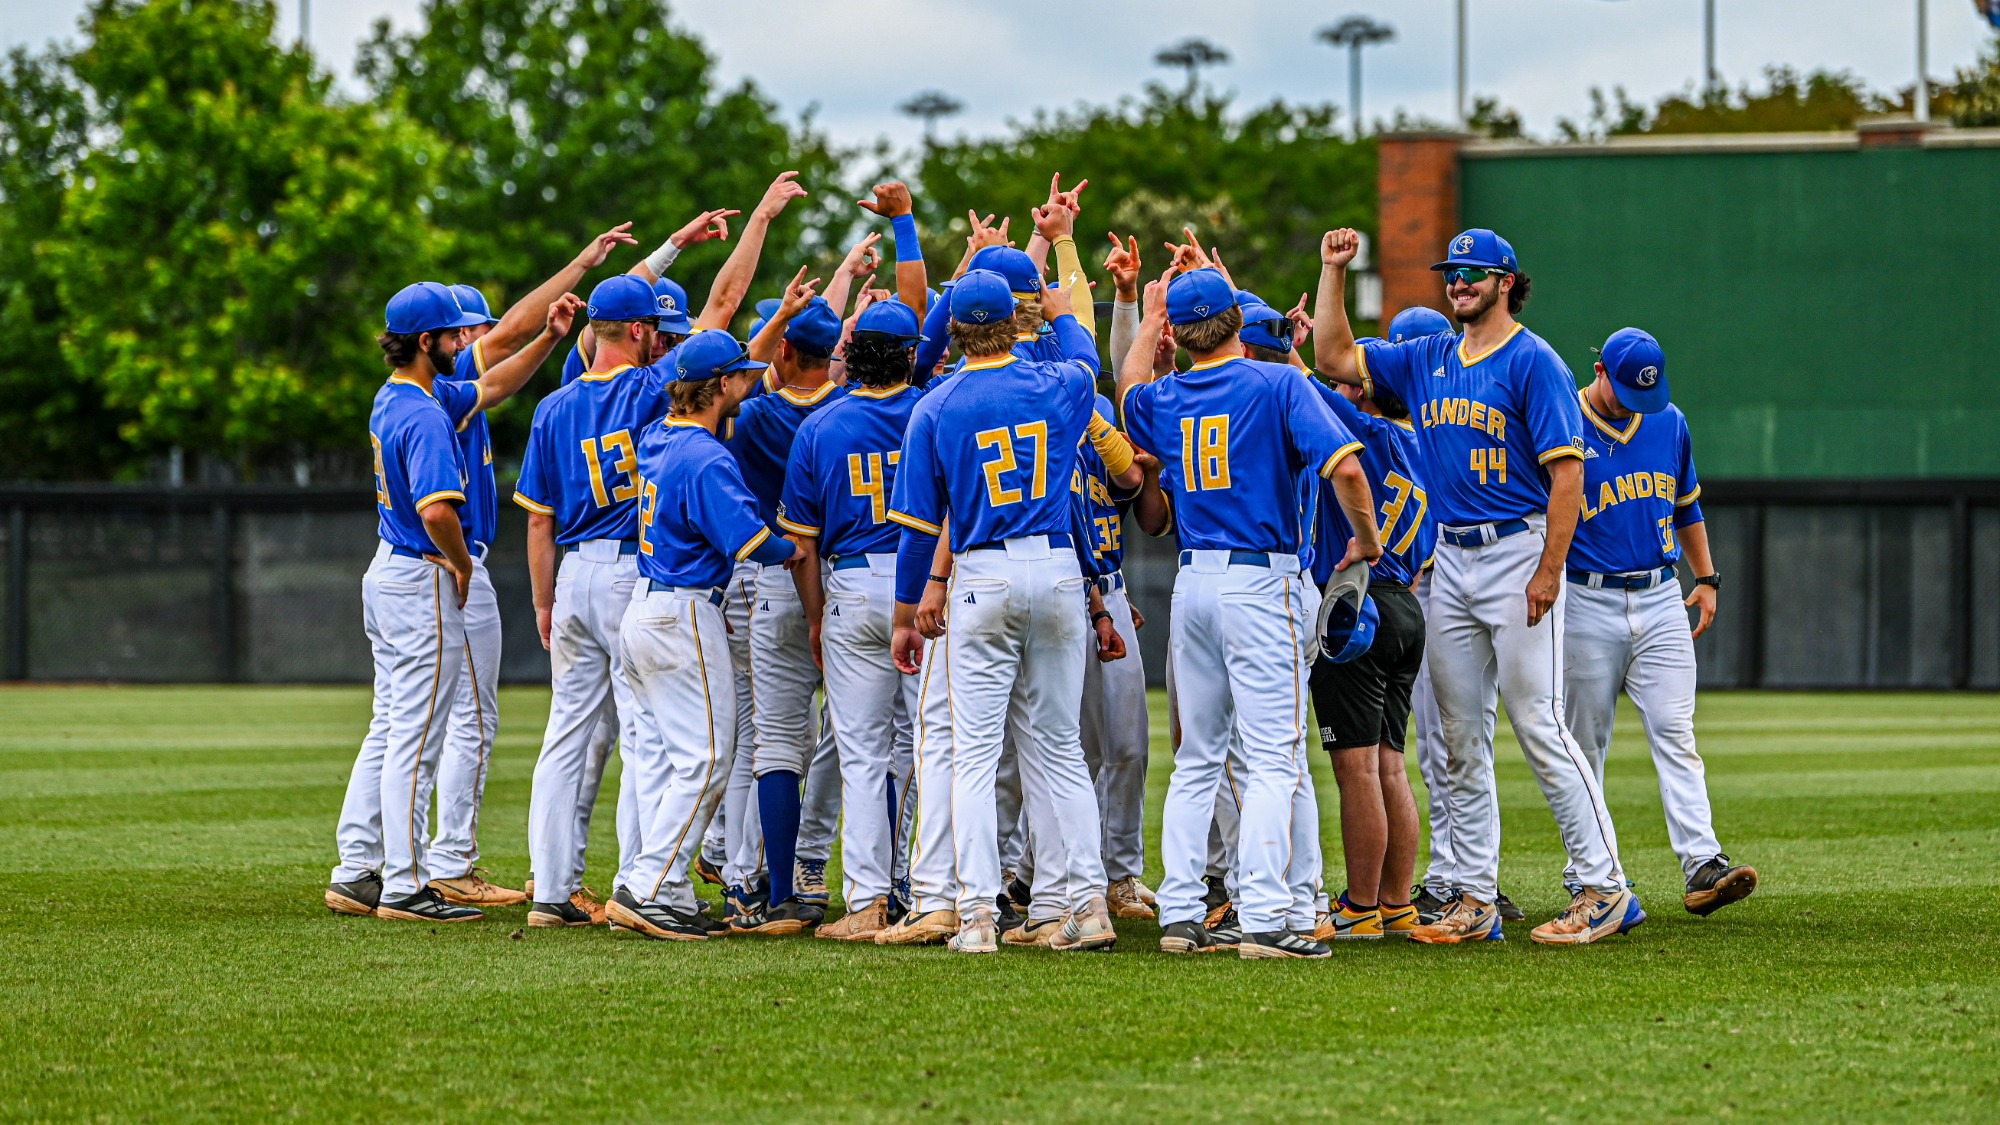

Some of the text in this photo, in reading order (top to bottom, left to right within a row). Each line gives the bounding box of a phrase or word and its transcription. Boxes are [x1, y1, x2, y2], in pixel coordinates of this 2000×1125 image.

[1180, 413, 1231, 493] 18
[1421, 397, 1507, 442] LANDER
[580, 428, 639, 509] 13
[847, 452, 901, 525] 4
[975, 419, 1047, 507] 27
[1470, 447, 1507, 485] 44
[1580, 471, 1676, 522] LANDER
[1094, 514, 1121, 552] 32
[1380, 470, 1428, 556] 37
